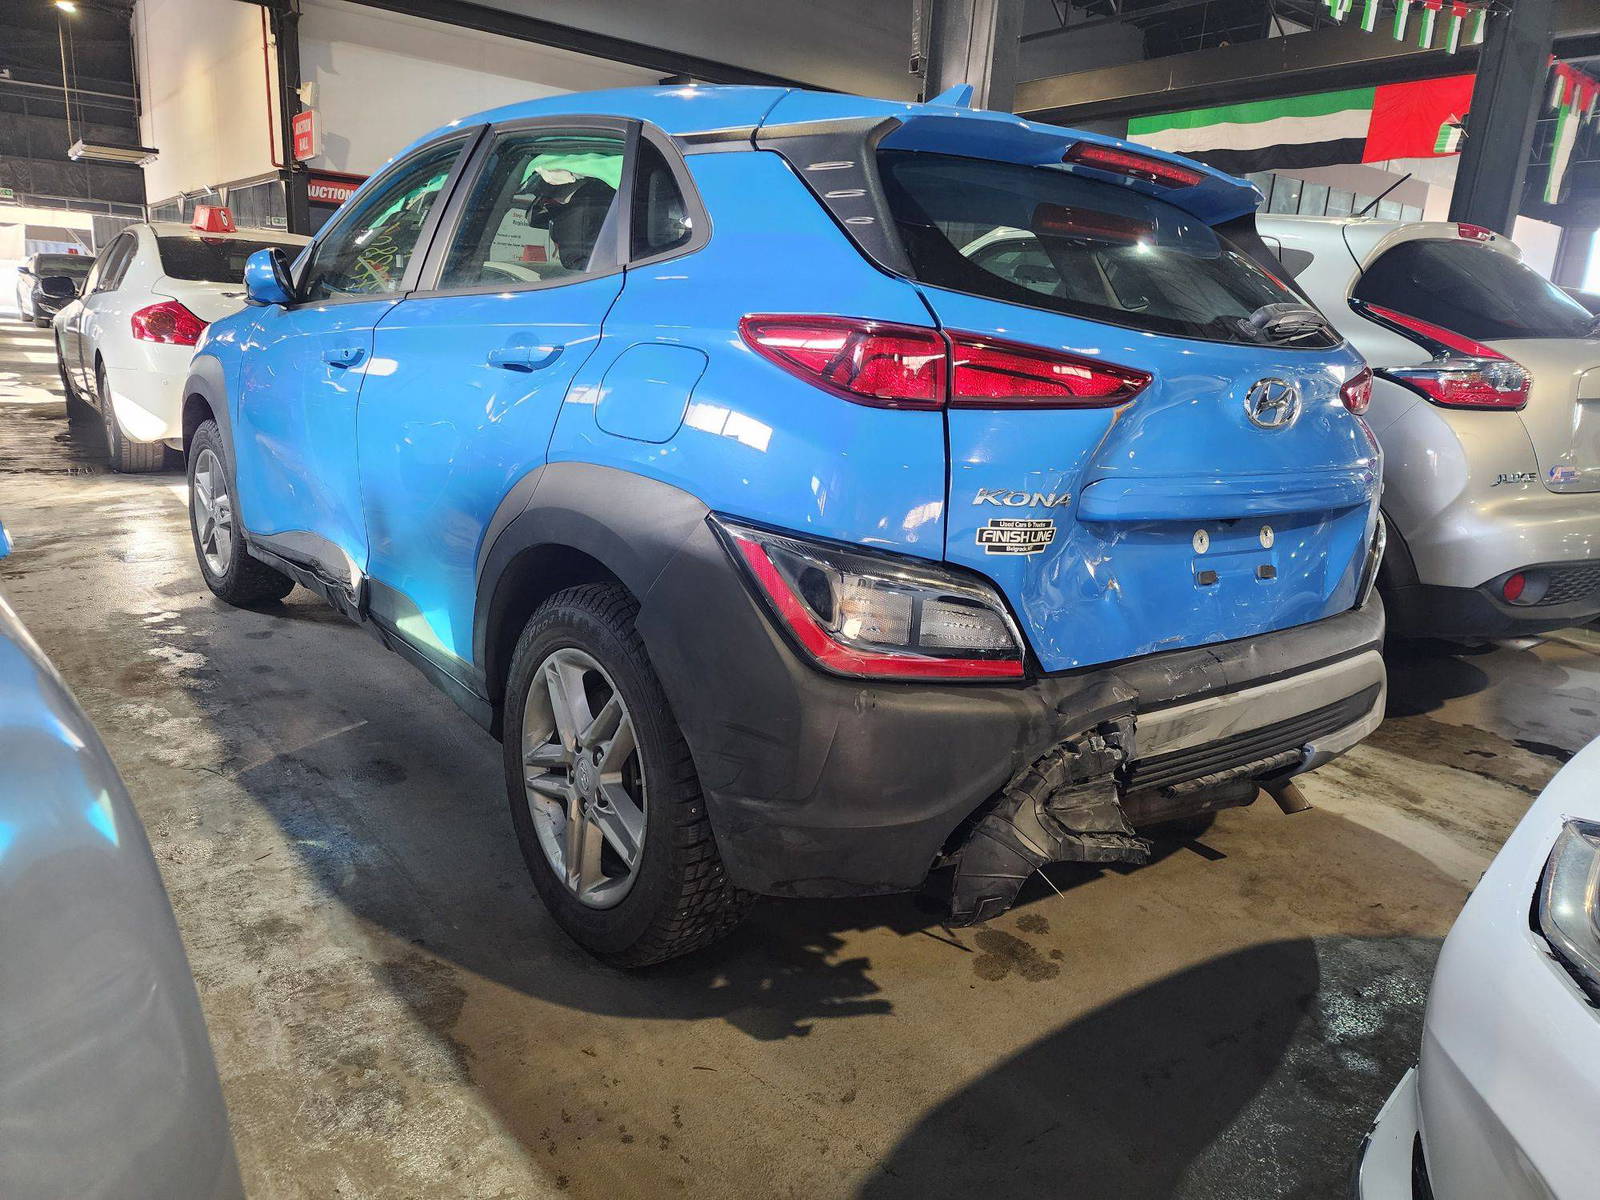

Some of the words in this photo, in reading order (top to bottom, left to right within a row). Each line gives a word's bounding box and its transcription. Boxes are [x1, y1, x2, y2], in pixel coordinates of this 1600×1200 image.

[1489, 472, 1536, 487] JUKE
[972, 488, 1072, 508] KONA
[982, 530, 1030, 542] FINISH
[1031, 530, 1053, 542] LINE
